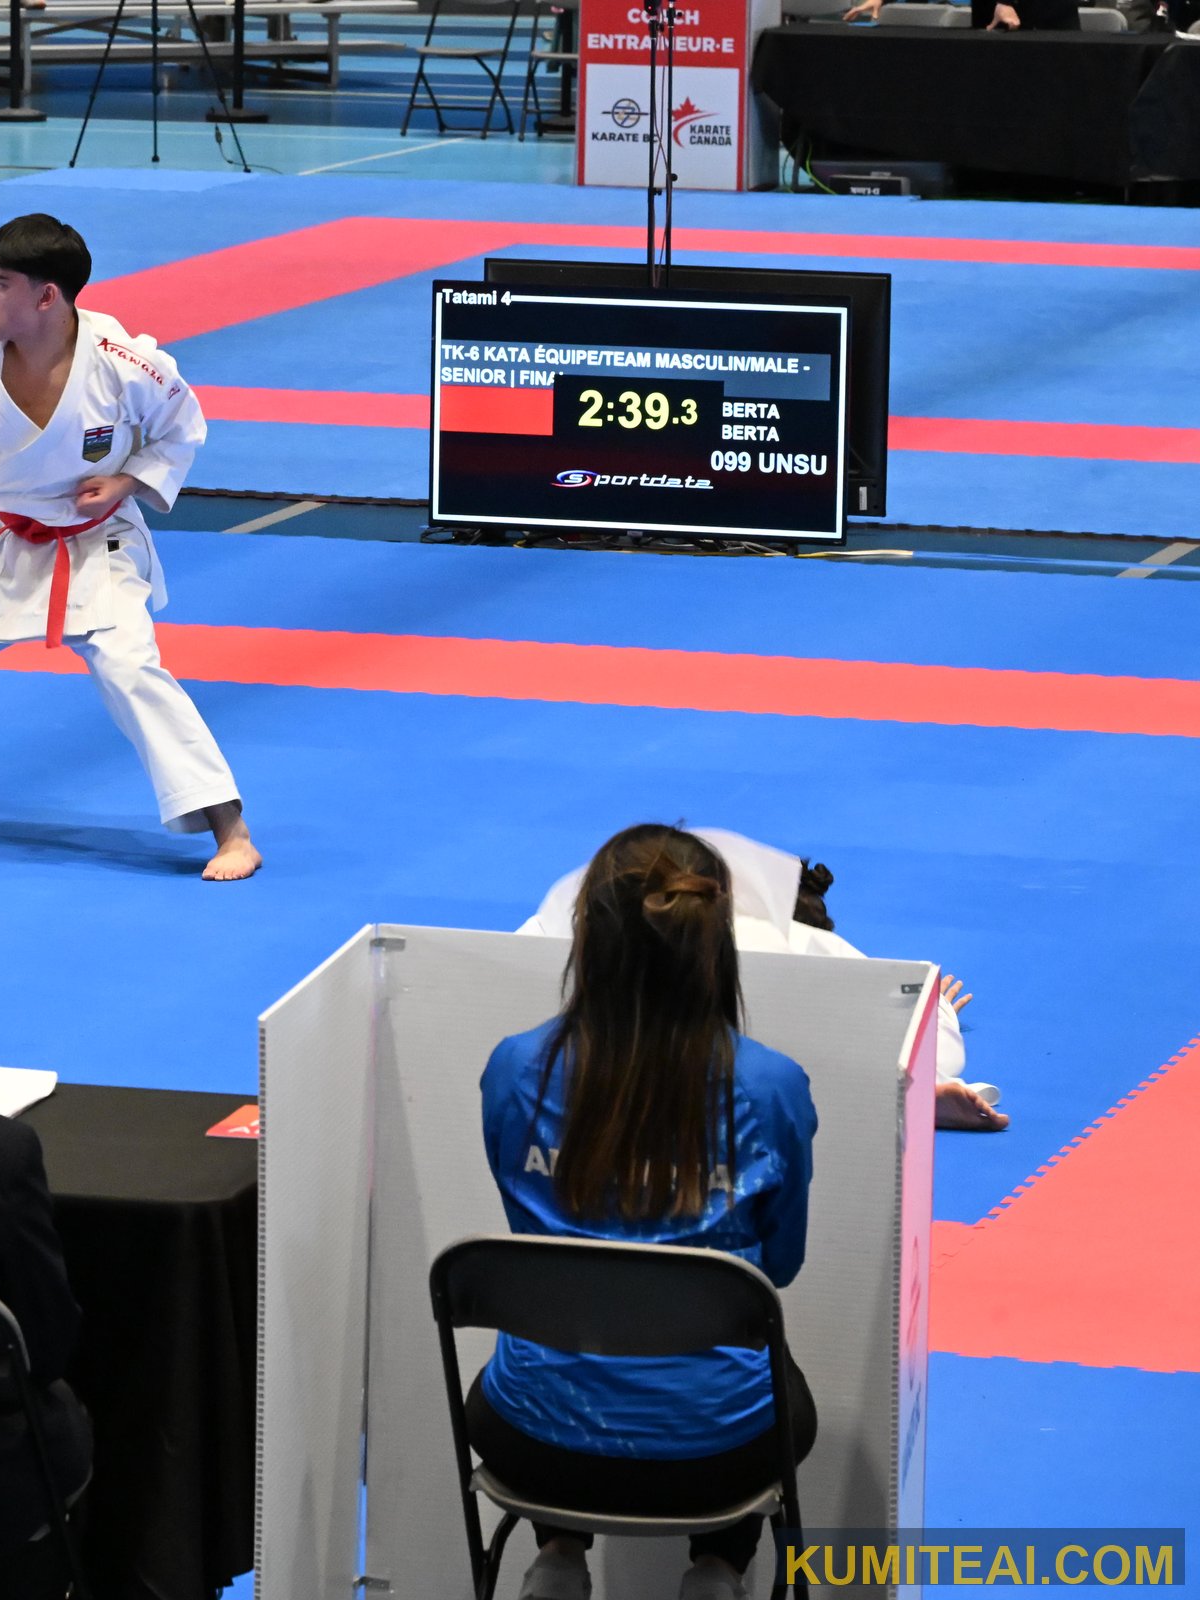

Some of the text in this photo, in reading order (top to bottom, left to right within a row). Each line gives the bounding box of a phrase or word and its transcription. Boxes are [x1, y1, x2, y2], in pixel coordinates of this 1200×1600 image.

[591, 132, 639, 142] KARATE
[690, 124, 731, 135] KARATE
[689, 135, 732, 146] CANADA
[441, 288, 512, 306] Tatami 4
[97, 337, 164, 385] Arawaza
[441, 344, 480, 361] TK-6
[484, 346, 531, 363] KATA
[534, 345, 650, 368] ÉQUIPE/TEAM
[655, 352, 799, 374] MASCULIN/MALE
[441, 366, 506, 384] SENIOR
[519, 370, 564, 387] FINA
[578, 389, 698, 430] 2:39.3
[710, 450, 828, 475] 099 UNSU
